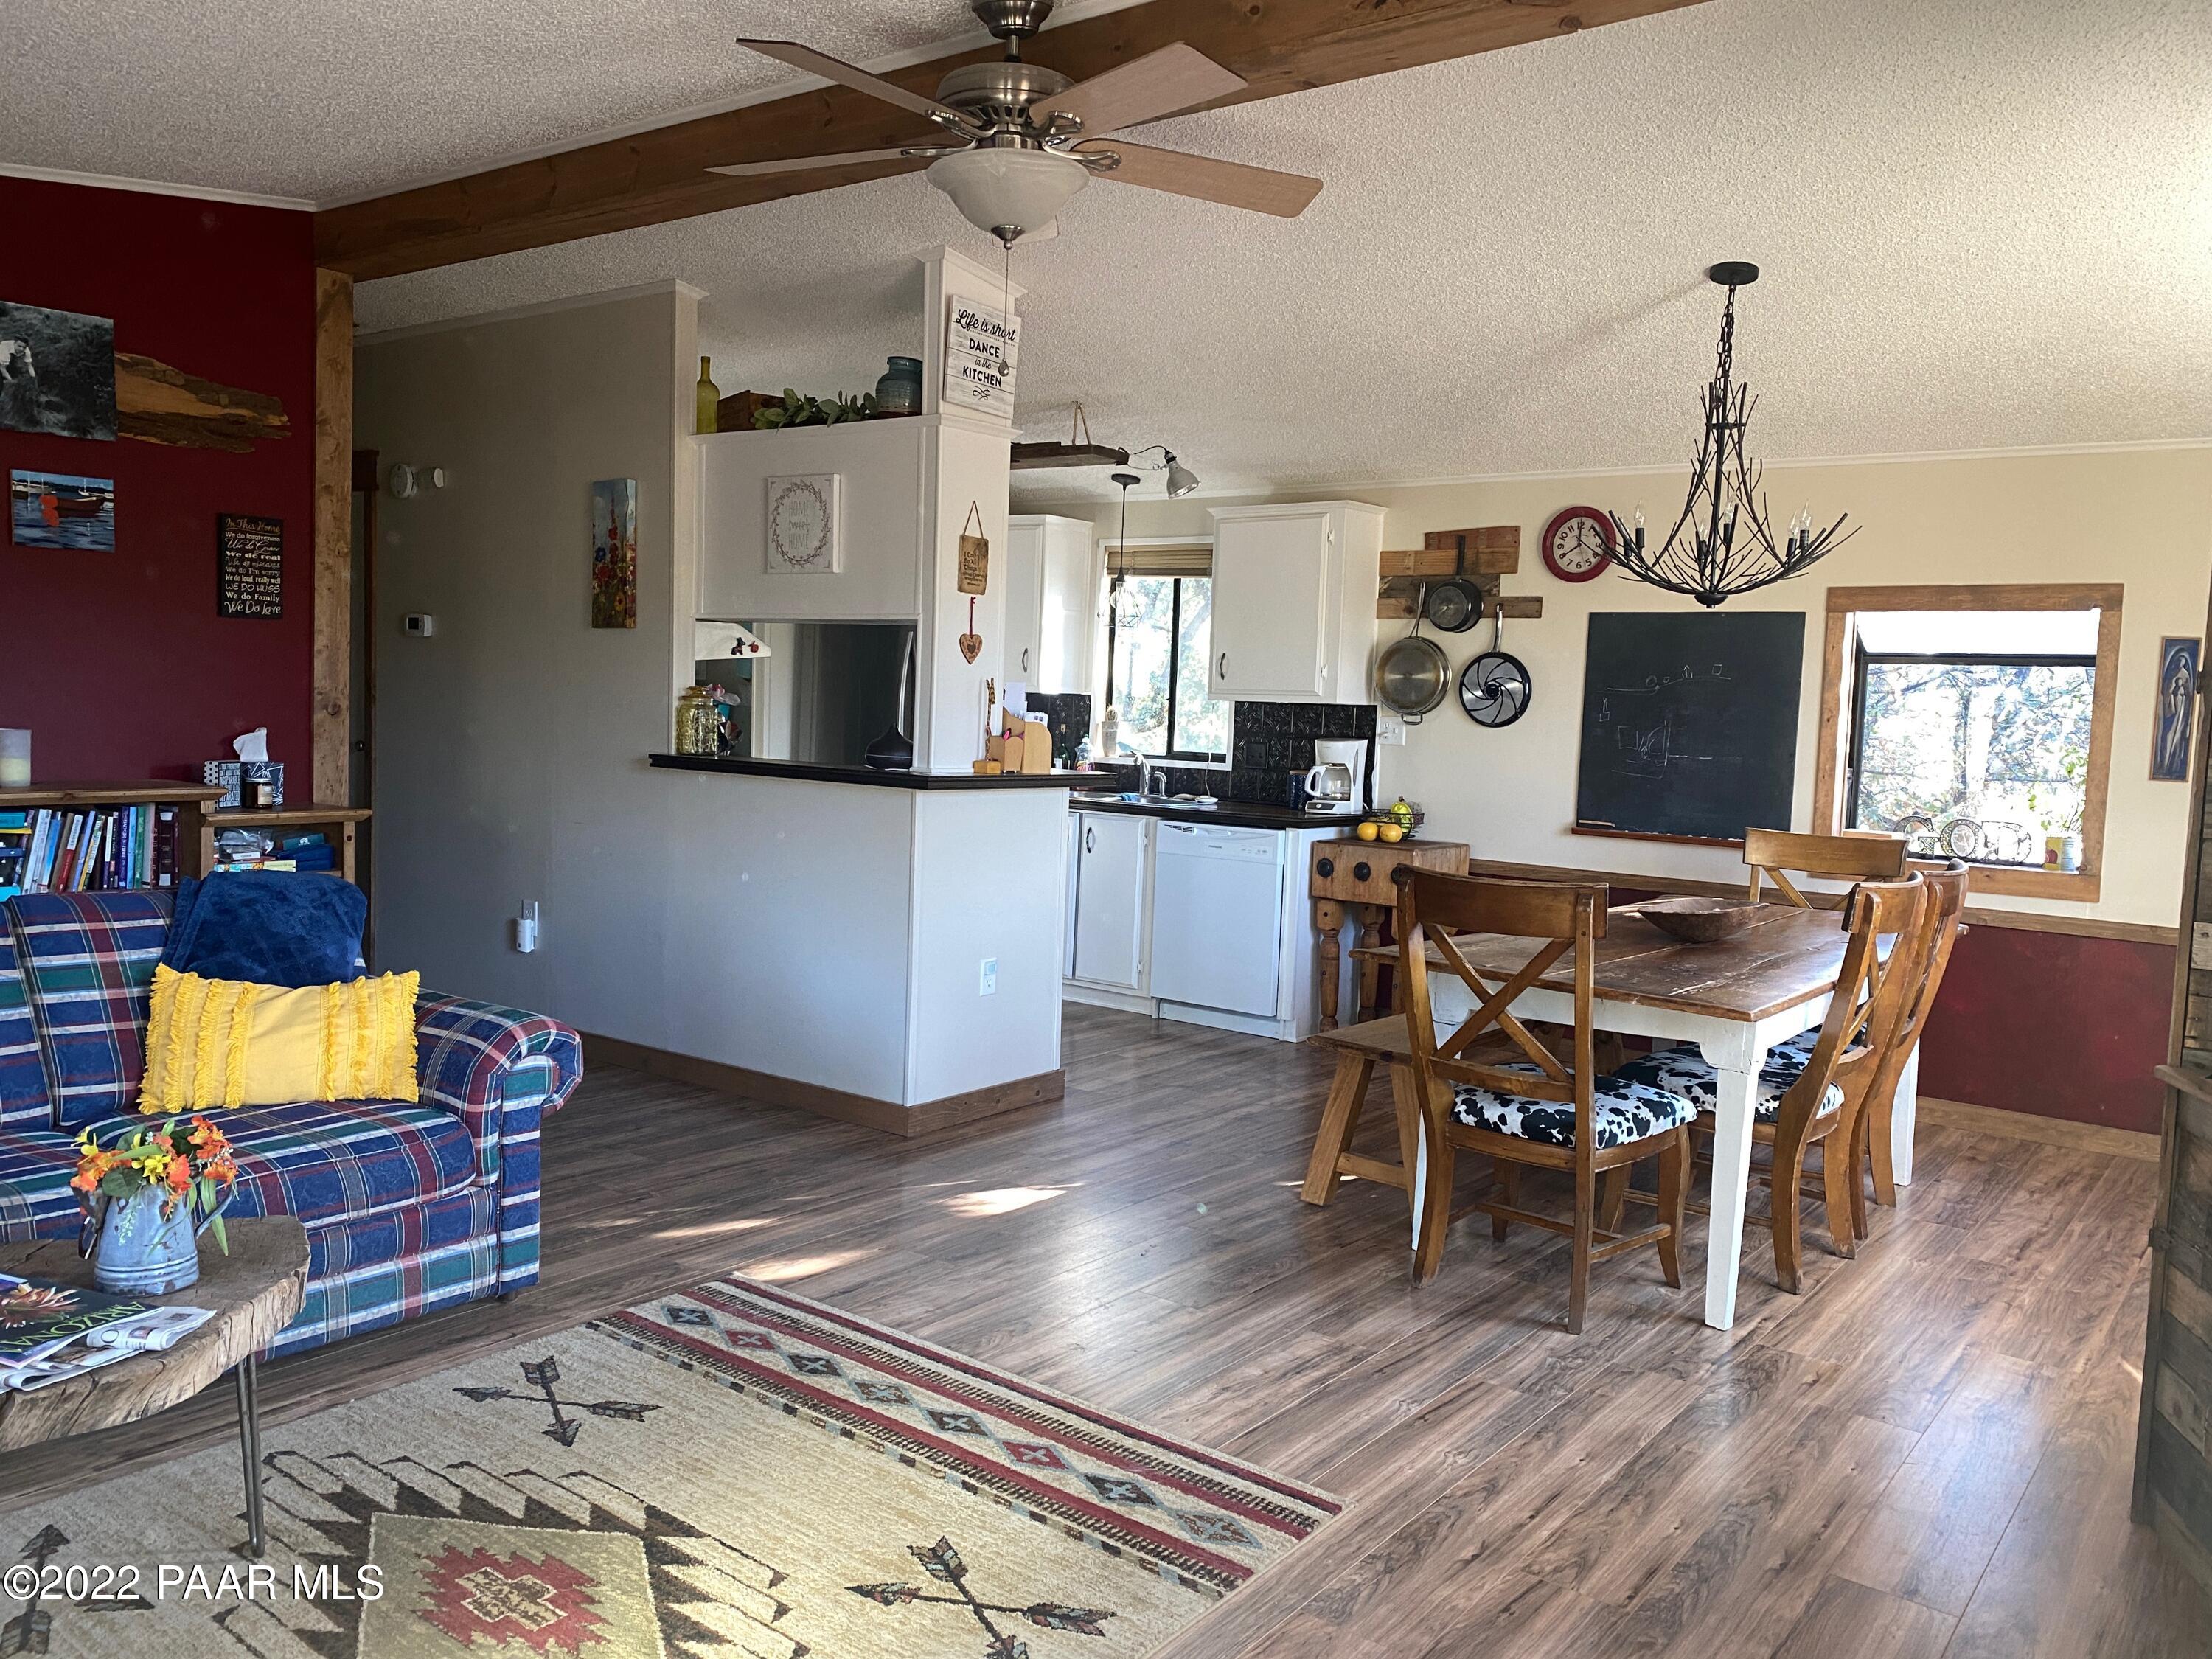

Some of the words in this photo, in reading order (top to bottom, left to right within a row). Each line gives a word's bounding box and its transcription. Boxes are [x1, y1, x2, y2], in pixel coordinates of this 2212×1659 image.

[956, 309, 980, 331] Life
[981, 319, 989, 332] is
[990, 324, 1016, 341] short
[969, 338, 1000, 358] DANCE
[975, 357, 981, 366] in
[981, 358, 992, 369] the
[962, 366, 1001, 388] KITCHEN
[789, 501, 809, 516] HOME
[237, 518, 255, 529] This
[1568, 525, 1574, 533] 11
[789, 533, 808, 549] HOME
[1559, 532, 1568, 541] 10
[1585, 558, 1592, 566] 5
[257, 585, 280, 593] HUGS
[254, 594, 279, 603] Family
[224, 600, 243, 613] We
[246, 600, 260, 613] Do
[261, 602, 281, 615] Love
